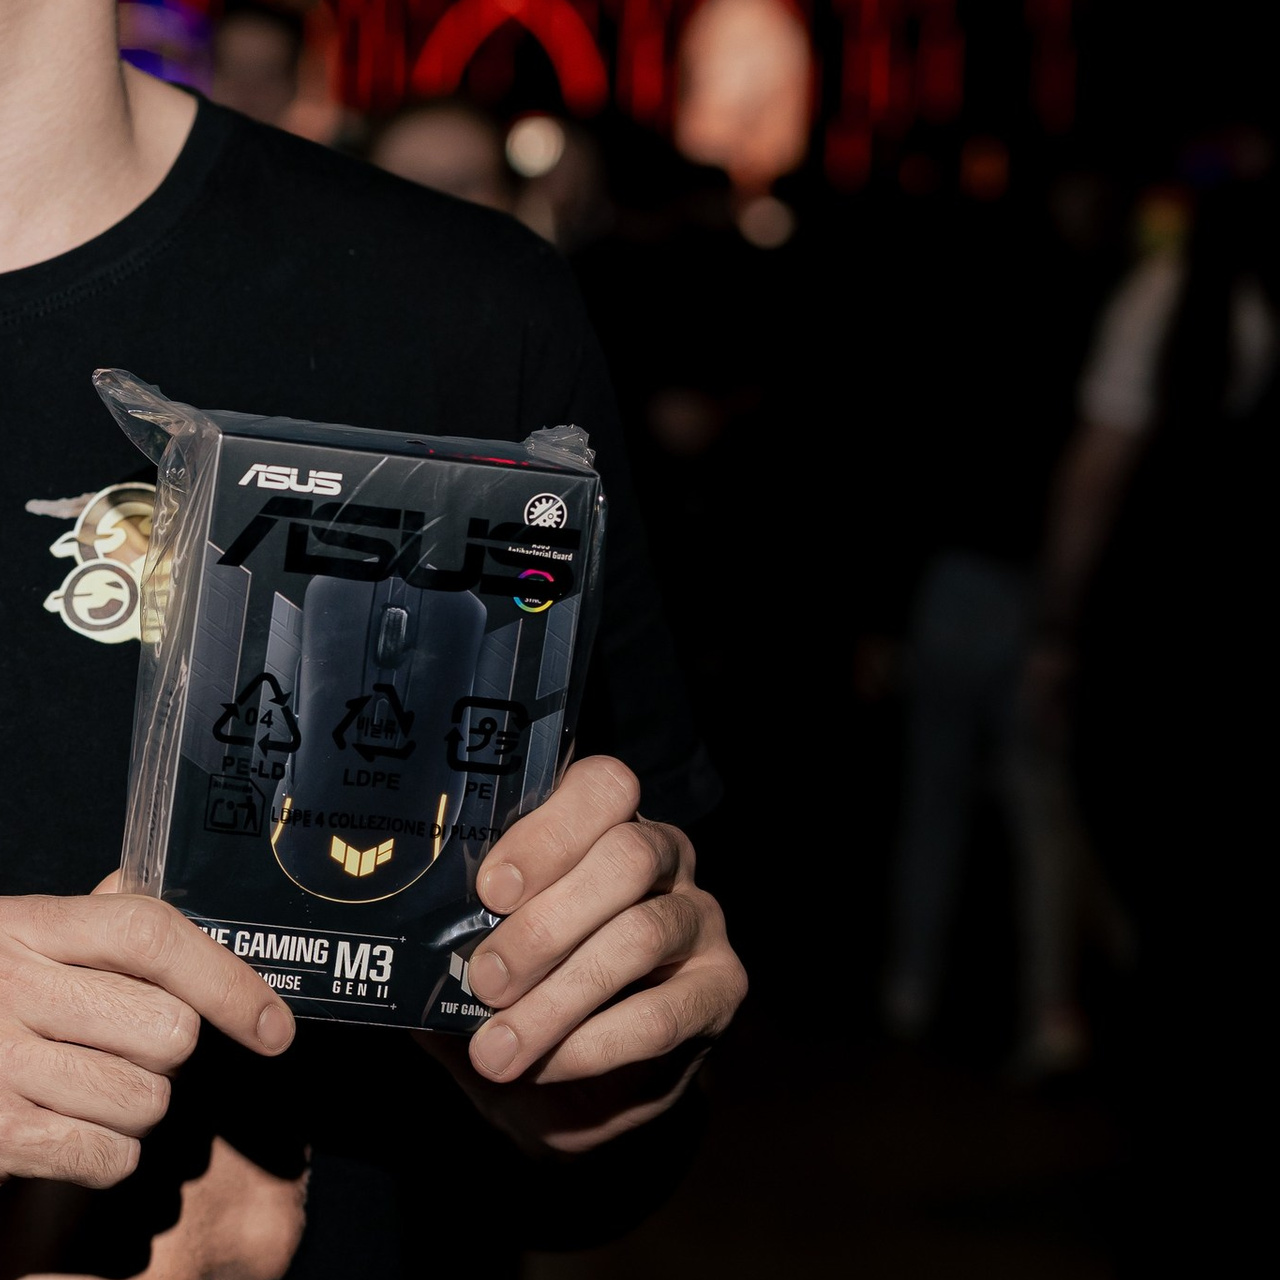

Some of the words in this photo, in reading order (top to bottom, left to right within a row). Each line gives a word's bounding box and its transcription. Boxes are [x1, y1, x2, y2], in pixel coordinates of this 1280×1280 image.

[238, 463, 343, 496] ASUS
[217, 496, 582, 600] ASUS
[552, 551, 573, 561] Guard
[222, 755, 286, 780] PE-LD
[343, 769, 401, 790] LDPE
[465, 782, 493, 800] PE
[329, 811, 426, 837] COLLEZIONE
[430, 823, 446, 839] DI
[233, 930, 329, 965] GAMING
[333, 940, 395, 983] M3
[332, 980, 368, 997] GEN
[440, 1001, 459, 1014] TUF
